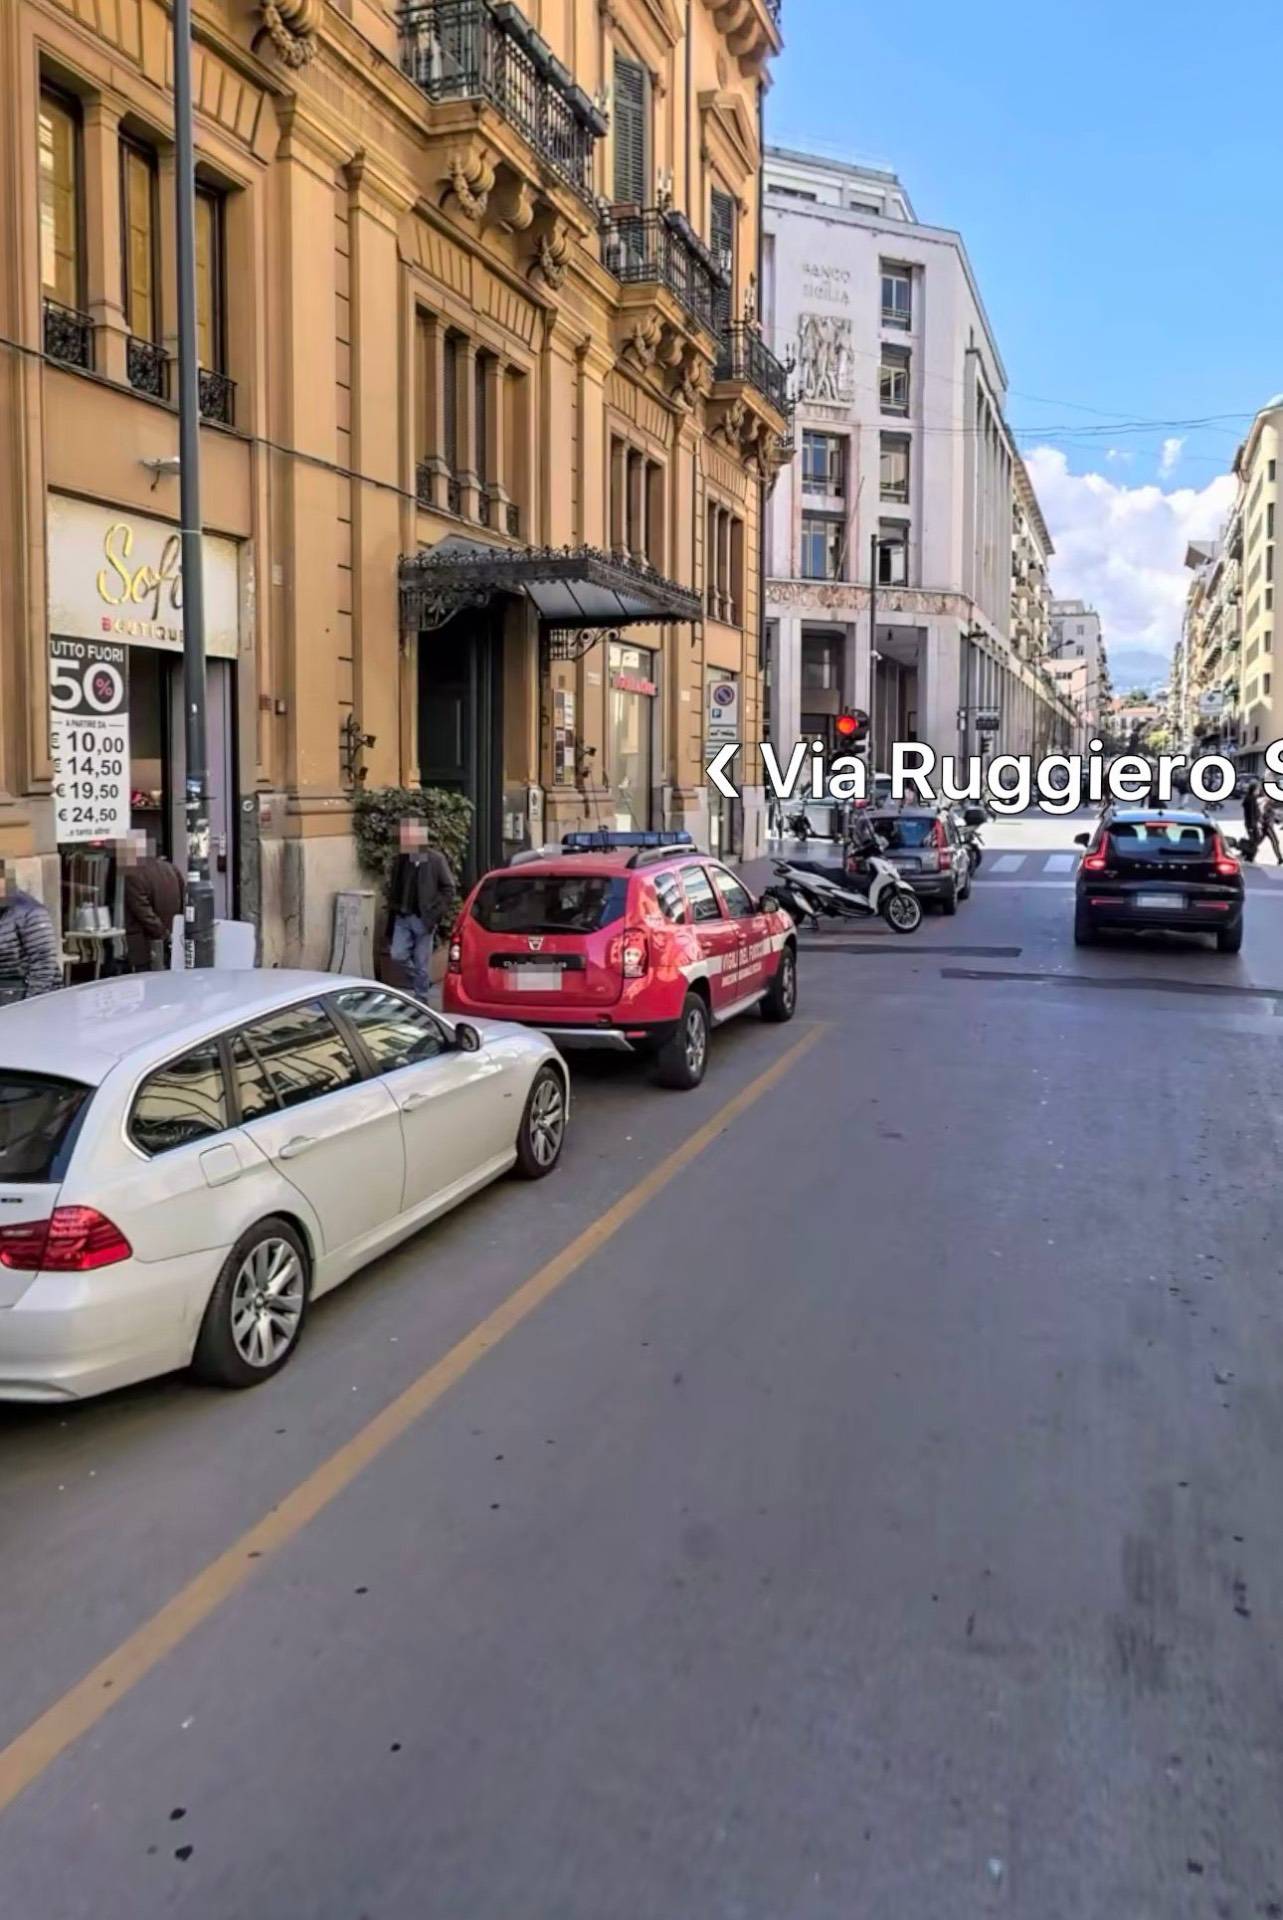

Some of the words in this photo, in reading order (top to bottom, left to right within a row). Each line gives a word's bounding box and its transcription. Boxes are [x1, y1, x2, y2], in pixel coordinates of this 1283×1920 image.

[88, 645, 124, 662] FUORI
[67, 730, 124, 756] 10,00
[68, 756, 122, 778] 14,50
[56, 783, 66, 798] €
[70, 782, 119, 801] 19,50
[58, 808, 67, 822] €
[72, 806, 117, 823] 24,50
